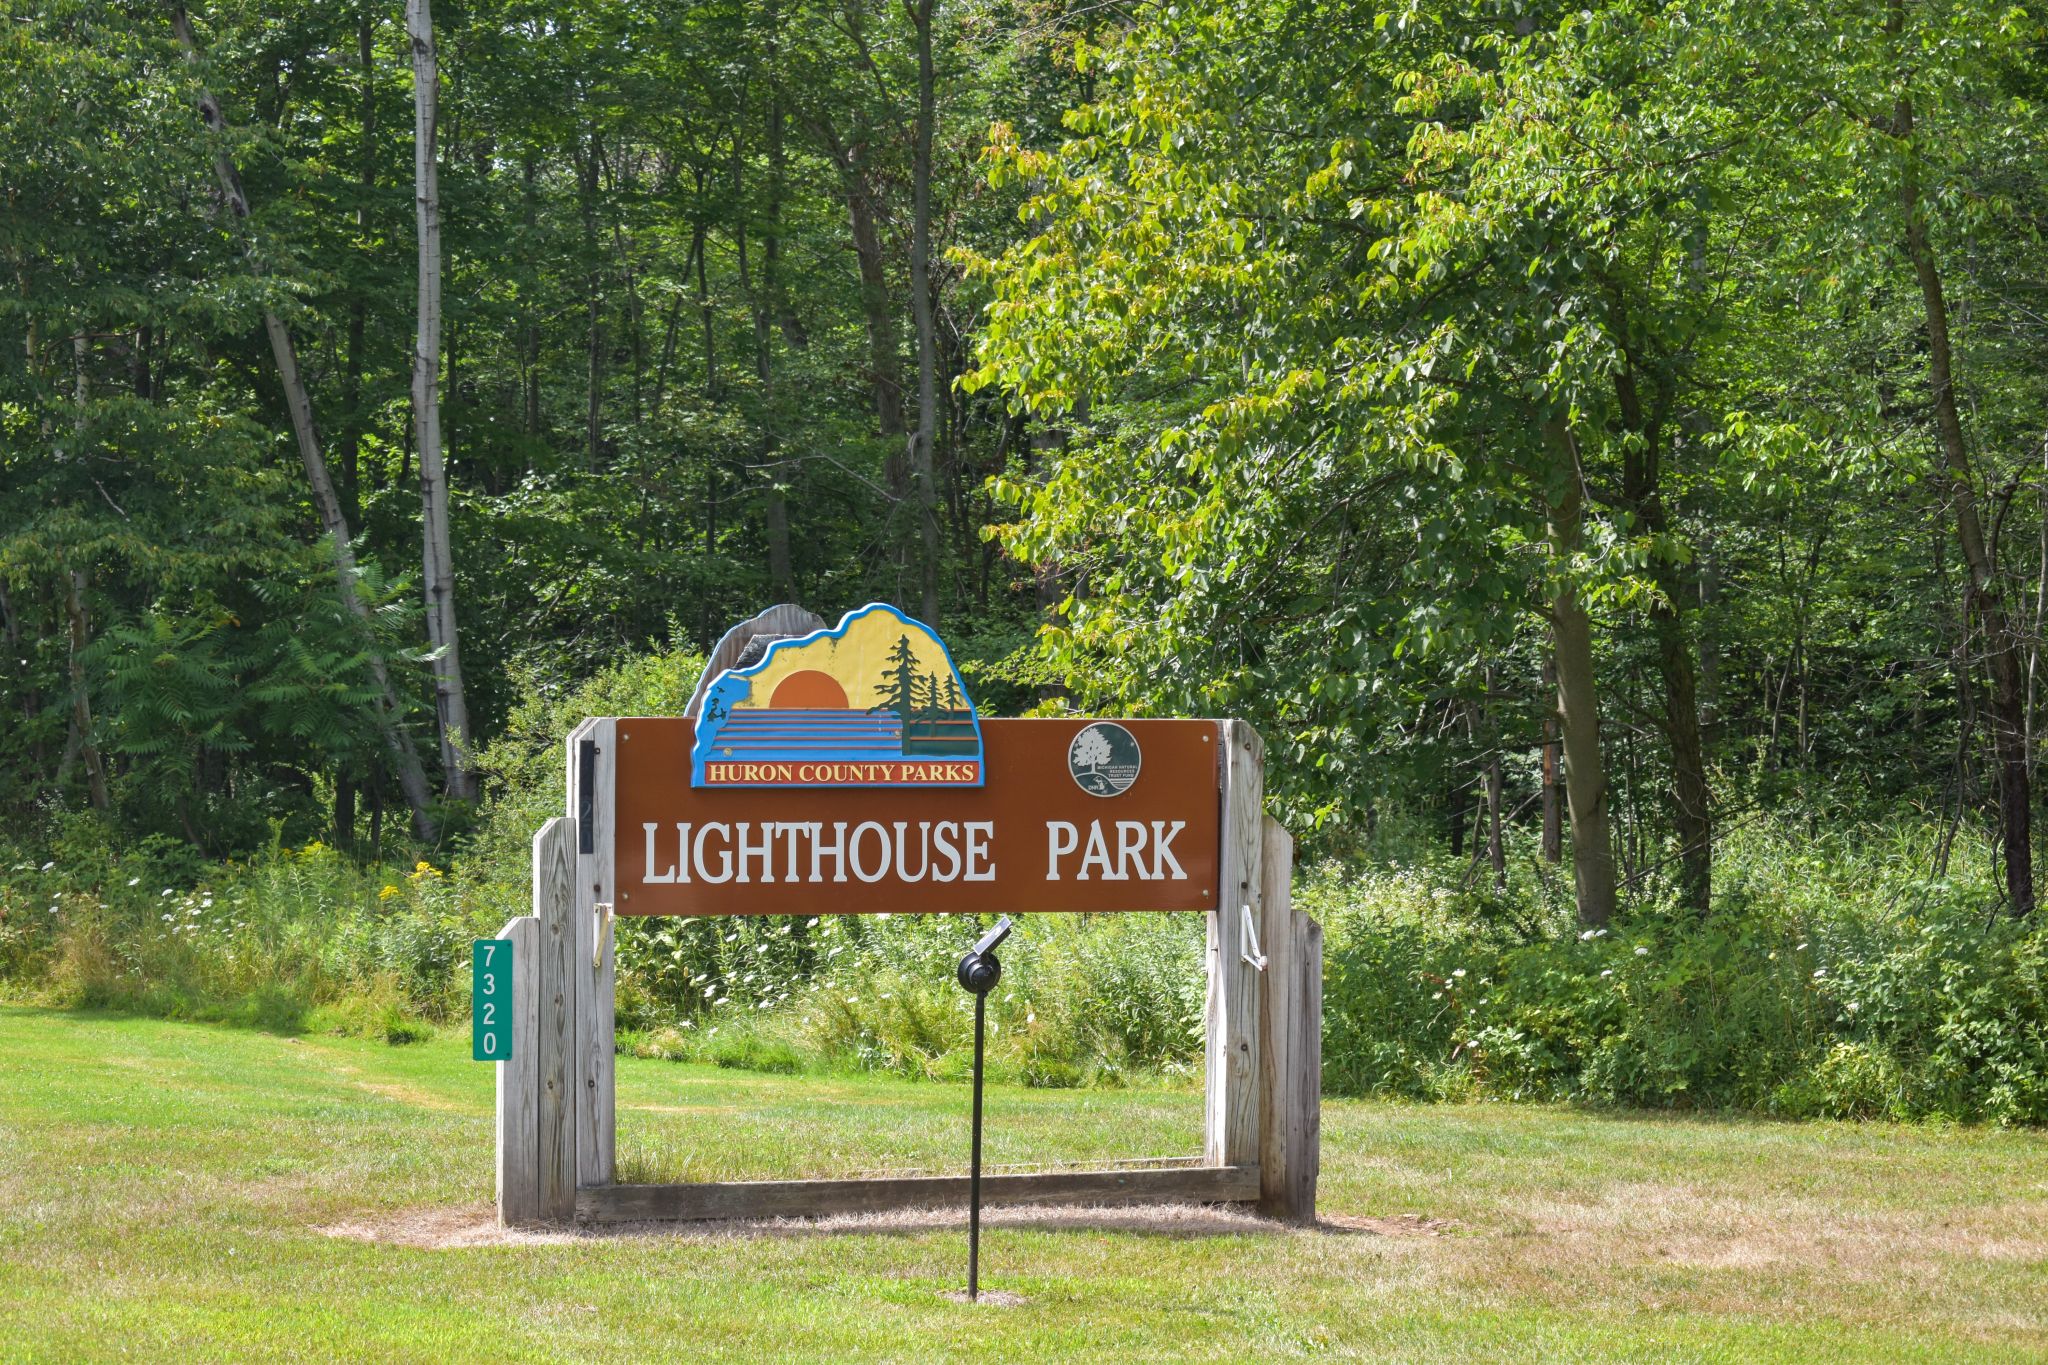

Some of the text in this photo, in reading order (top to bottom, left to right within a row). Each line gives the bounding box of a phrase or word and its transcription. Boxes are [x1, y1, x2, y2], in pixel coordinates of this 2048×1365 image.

[709, 764, 974, 782] HURON COUNTY PARKS
[642, 819, 1188, 884] LIGHTHOUSE PARK
[483, 945, 497, 1055] 7320
